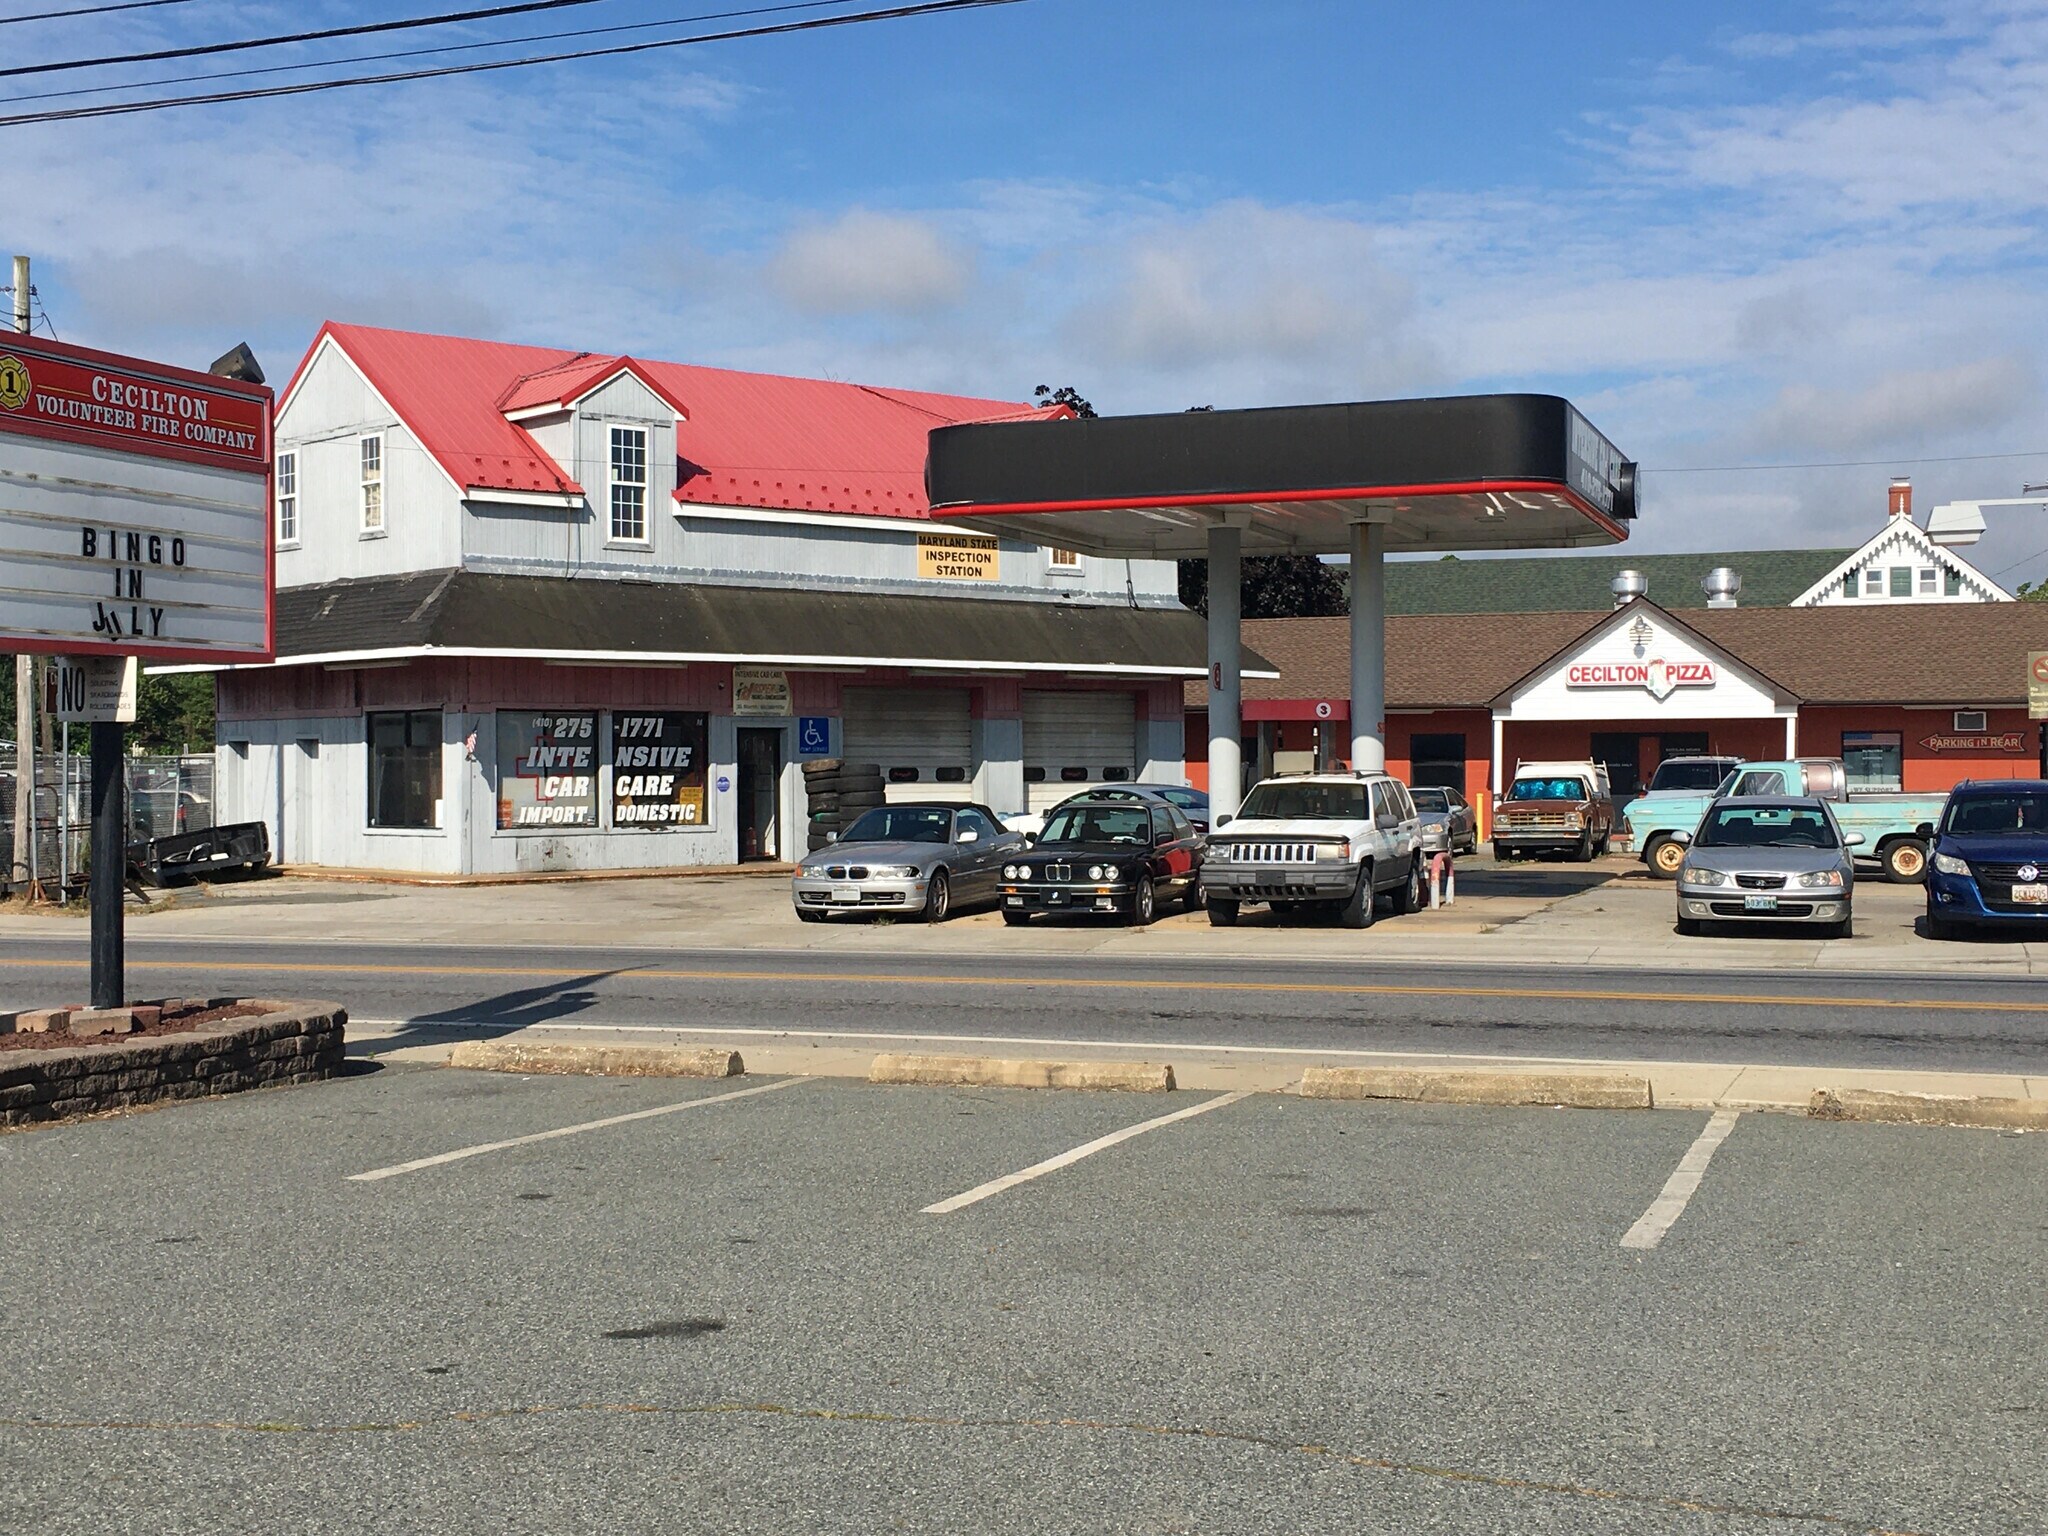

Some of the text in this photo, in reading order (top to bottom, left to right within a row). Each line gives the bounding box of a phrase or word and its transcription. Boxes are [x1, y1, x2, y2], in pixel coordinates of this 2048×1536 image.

[5, 371, 16, 393] 1
[92, 375, 208, 420] CECILTON
[36, 393, 256, 450] VOLUNTEER FIRE COMPANY
[82, 527, 185, 566] BINGO
[918, 535, 998, 549] MARYLAND STATE
[926, 550, 992, 563] INSPECTION
[936, 565, 983, 577] STATION
[115, 568, 142, 598] IN
[93, 602, 163, 641] JULY
[1569, 665, 1712, 682] CECILTON PIZZA
[61, 667, 85, 712] NO
[1319, 705, 1328, 715] 3
[532, 717, 552, 729] (410)
[553, 718, 593, 738] 275
[1930, 736, 2018, 748] PARKING IN REAR
[526, 747, 692, 767] INTE NSIVE
[544, 777, 590, 797] CAR
[616, 775, 675, 796] CARE
[518, 806, 589, 824] IMPORT
[616, 804, 696, 822] DOMESTIC
